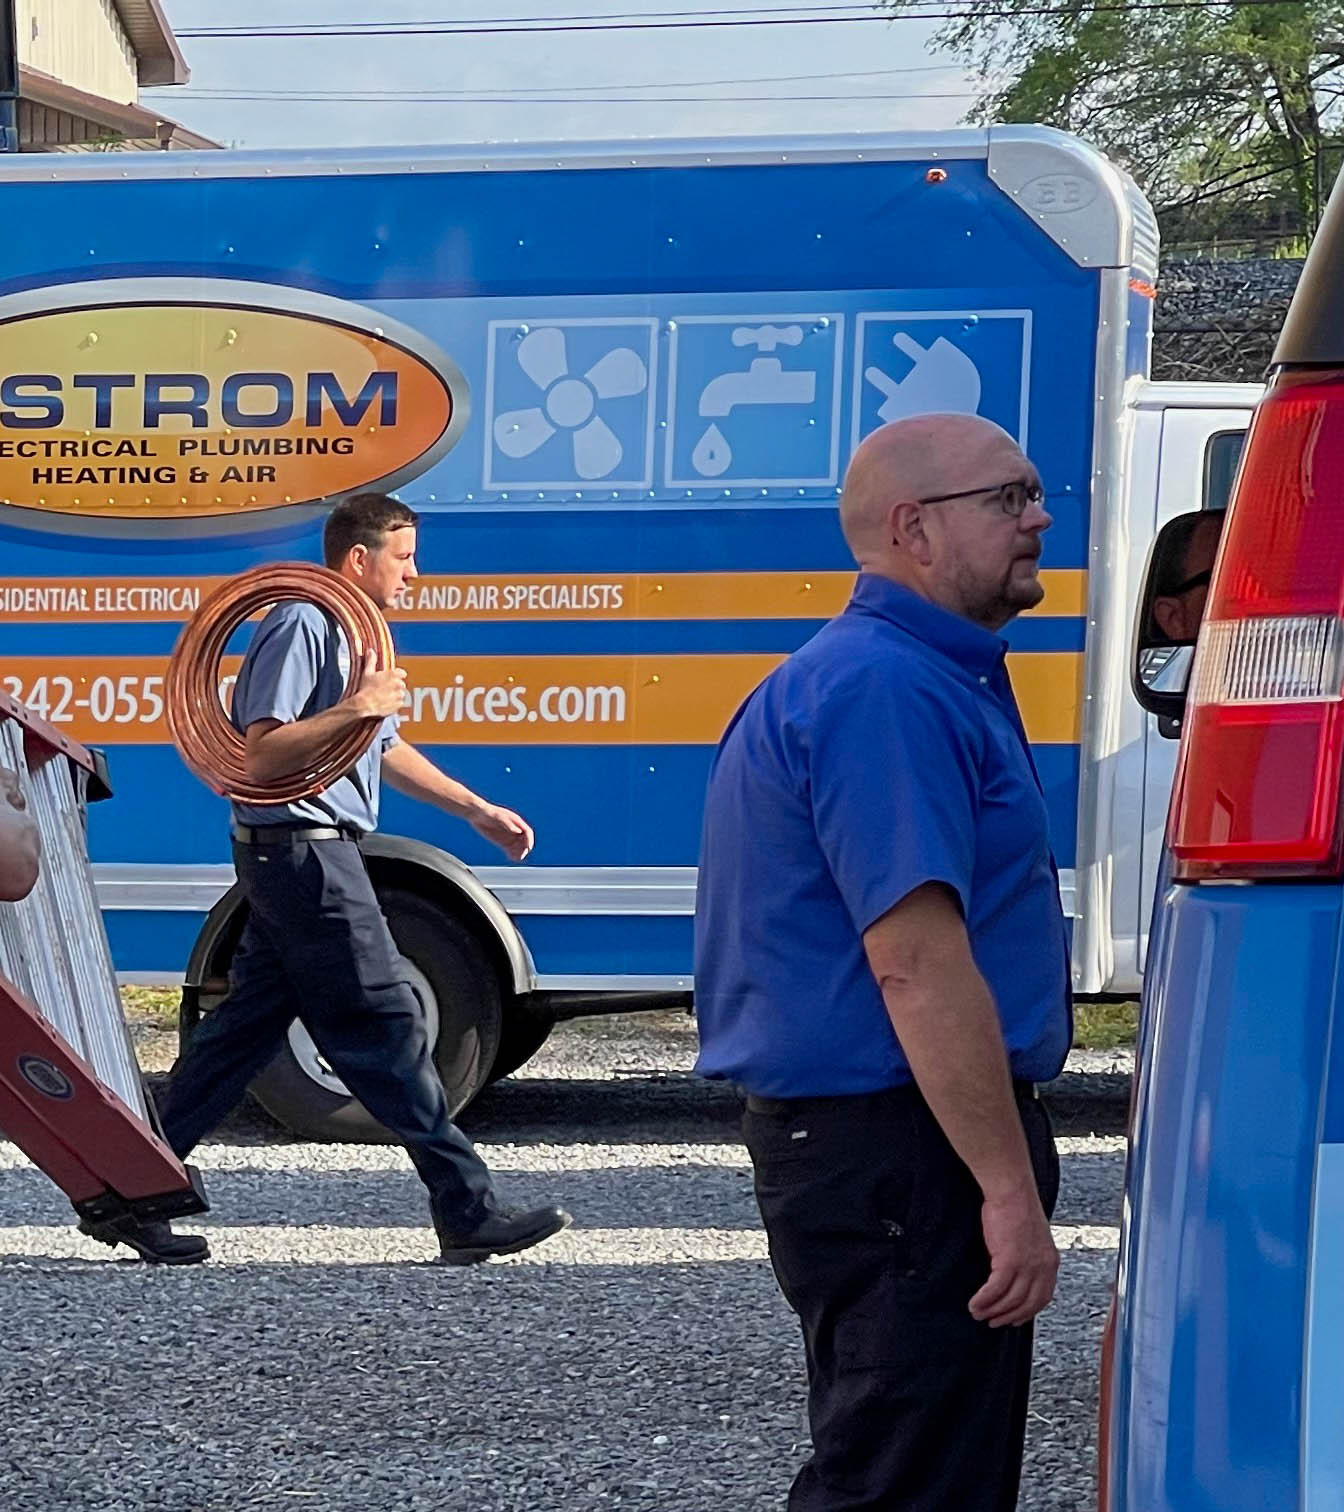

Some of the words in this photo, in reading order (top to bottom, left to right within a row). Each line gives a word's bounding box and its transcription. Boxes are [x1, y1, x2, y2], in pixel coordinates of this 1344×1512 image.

[179, 437, 355, 456] PLUMBING
[31, 466, 177, 485] HEATING
[189, 466, 210, 483] &
[221, 465, 277, 483] AIR
[418, 586, 462, 610] AND
[464, 585, 499, 610] AIR
[503, 584, 623, 610] SPECIALISTS
